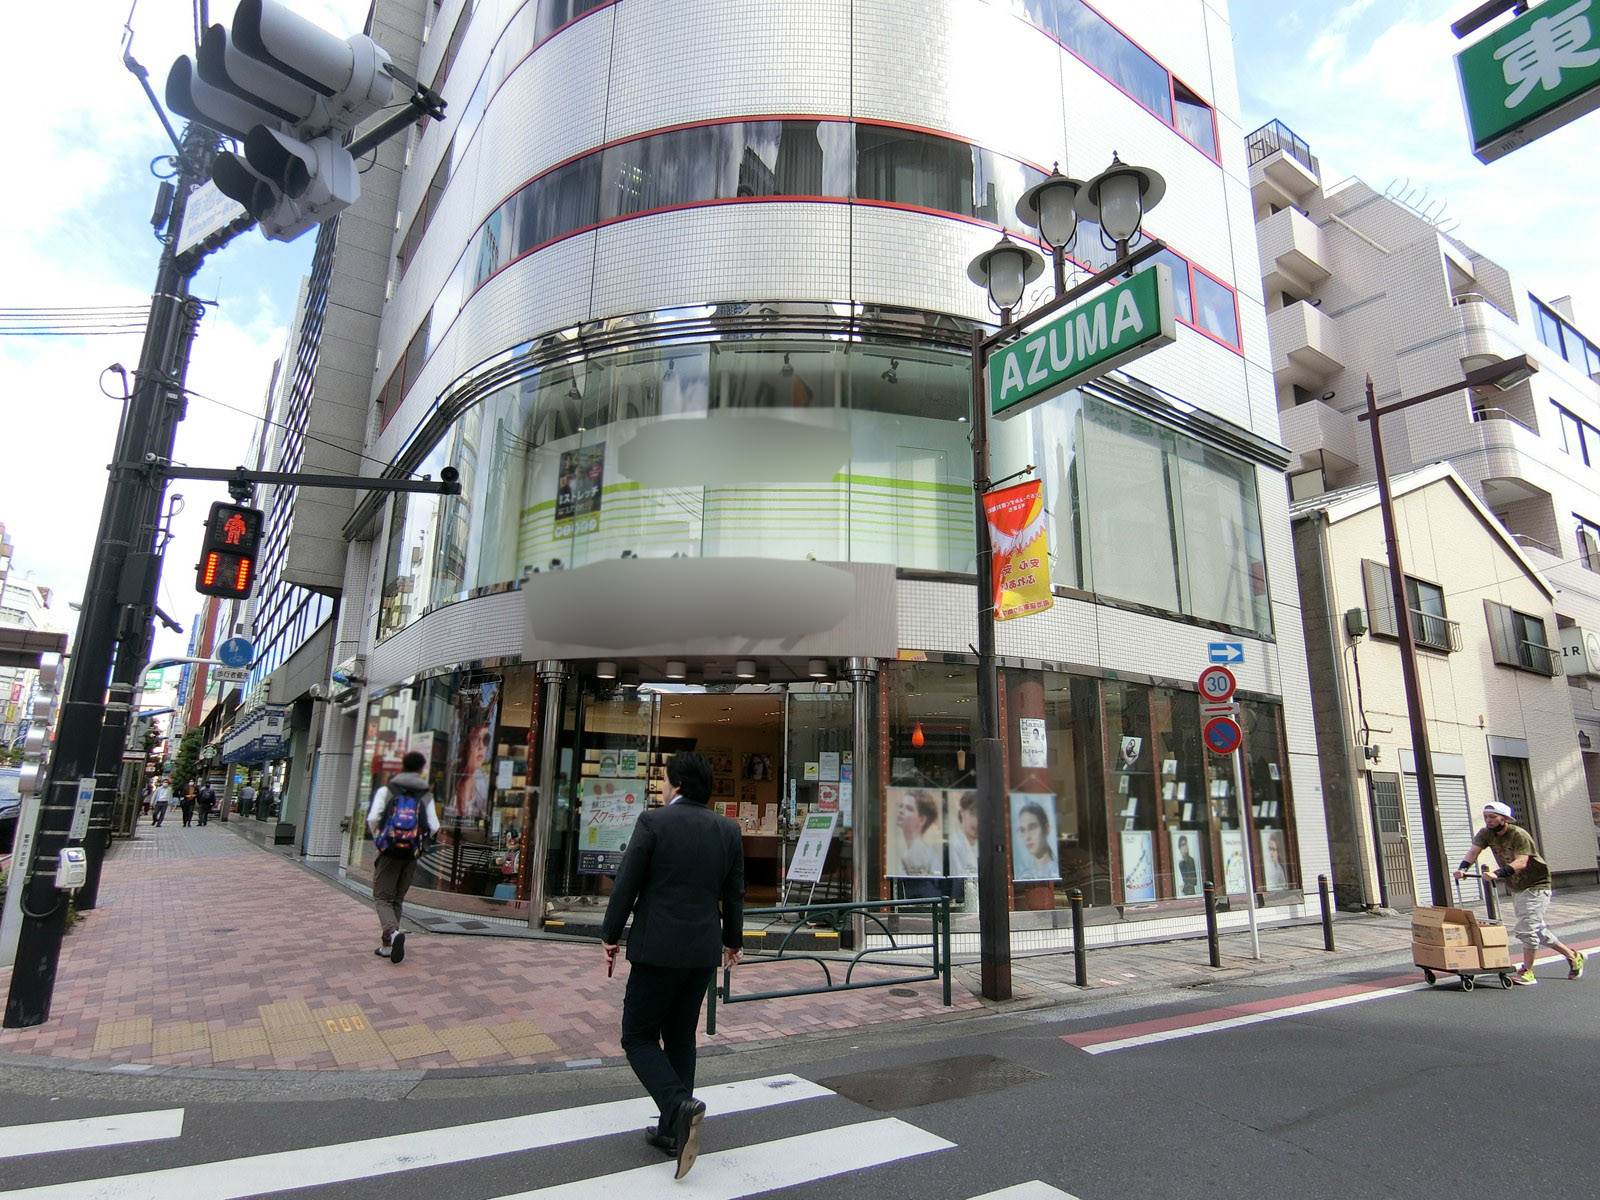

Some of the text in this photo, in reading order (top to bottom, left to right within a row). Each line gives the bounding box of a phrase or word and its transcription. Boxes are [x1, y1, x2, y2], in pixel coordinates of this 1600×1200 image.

[1493, 0, 1600, 109] 東
[999, 287, 1143, 401] AZUMA
[217, 670, 249, 680] 歩行者優先
[1207, 676, 1228, 692] 30
